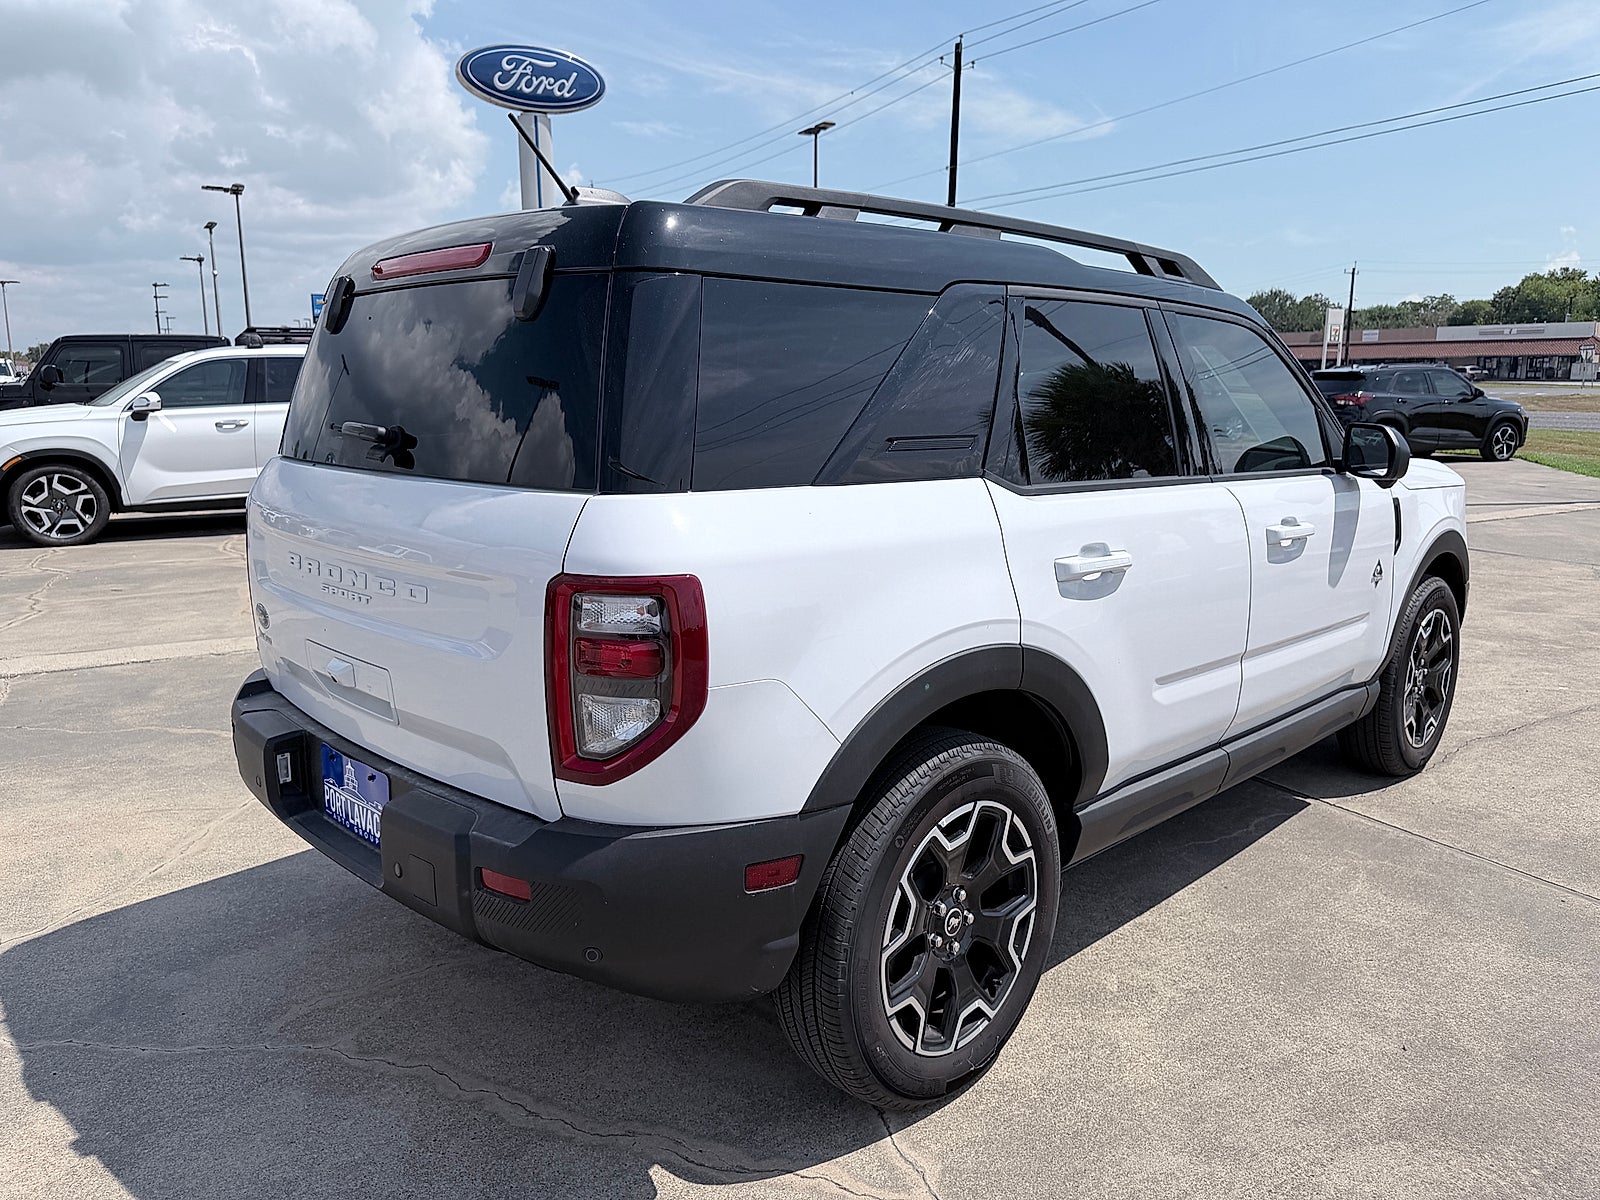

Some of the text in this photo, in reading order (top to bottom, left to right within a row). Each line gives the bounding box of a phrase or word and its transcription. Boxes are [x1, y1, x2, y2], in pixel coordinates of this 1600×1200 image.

[493, 54, 577, 98] Ford
[288, 550, 429, 604] BRONCO
[320, 582, 373, 605] SPORT
[324, 784, 381, 838] PORT LAVAC
[354, 826, 380, 844] GROUP
